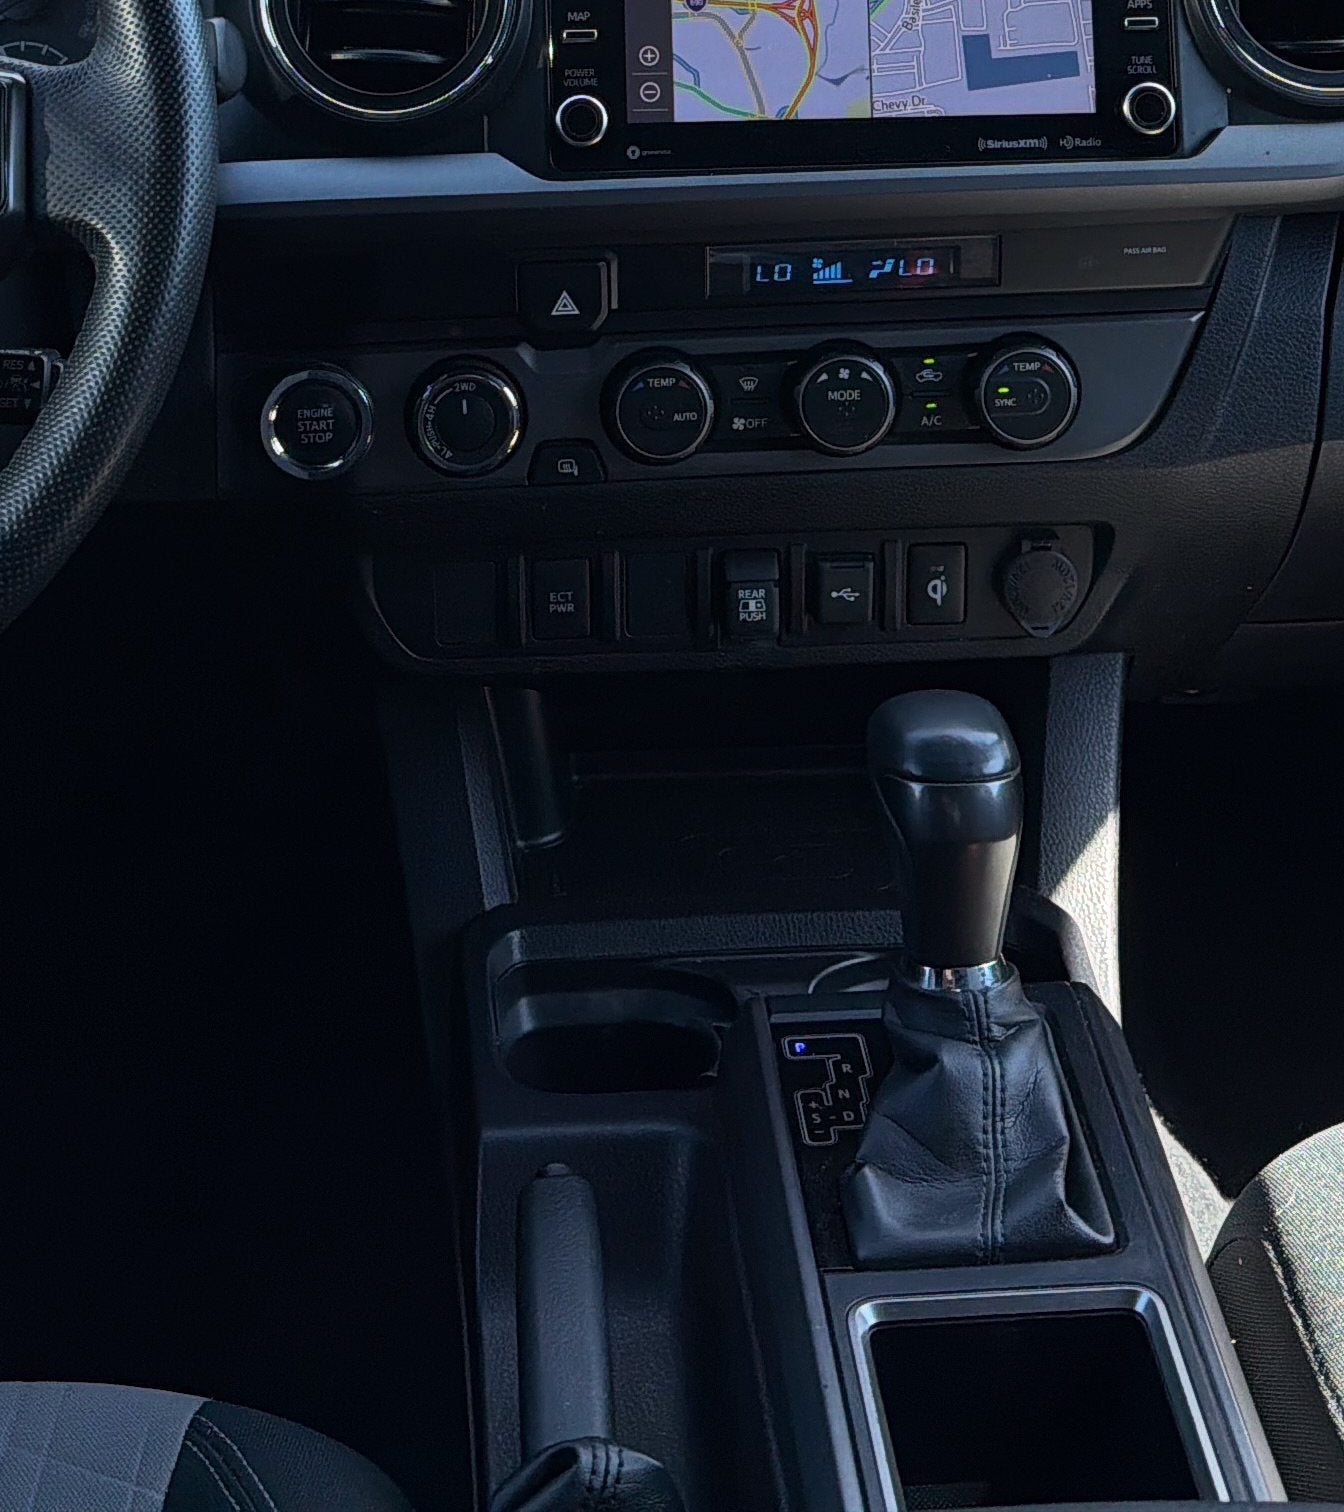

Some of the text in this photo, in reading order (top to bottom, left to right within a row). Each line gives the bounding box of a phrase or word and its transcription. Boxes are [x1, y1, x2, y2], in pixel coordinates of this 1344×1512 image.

[1126, 0, 1152, 9] APPS
[567, 11, 591, 22] MAP
[1131, 55, 1153, 66] TUNE
[564, 68, 594, 78] POWER
[1126, 64, 1157, 75] SCROLL
[562, 77, 598, 88] VOLUME
[871, 95, 927, 114] Chevy Dr
[1074, 138, 1102, 148] Radio
[1123, 246, 1167, 255] PASS AIR BAG
[1013, 361, 1042, 372] TEMP
[454, 382, 477, 392] 2WD
[647, 377, 677, 388] TEMP
[827, 389, 862, 402] MODE
[994, 397, 1017, 407] SYNC
[297, 407, 334, 419] ENGINE
[672, 412, 698, 422] AUTO
[297, 419, 335, 432] START
[746, 418, 769, 429] OFF
[920, 415, 943, 427] A/C
[300, 433, 333, 444] STOP
[549, 591, 574, 602] ECT
[738, 589, 766, 599] REAR
[549, 603, 575, 614] PWR
[739, 611, 767, 622] PUSH
[794, 1042, 807, 1053] P
[841, 1063, 854, 1074] R
[838, 1088, 850, 1100] N
[811, 1110, 855, 1124] S D
